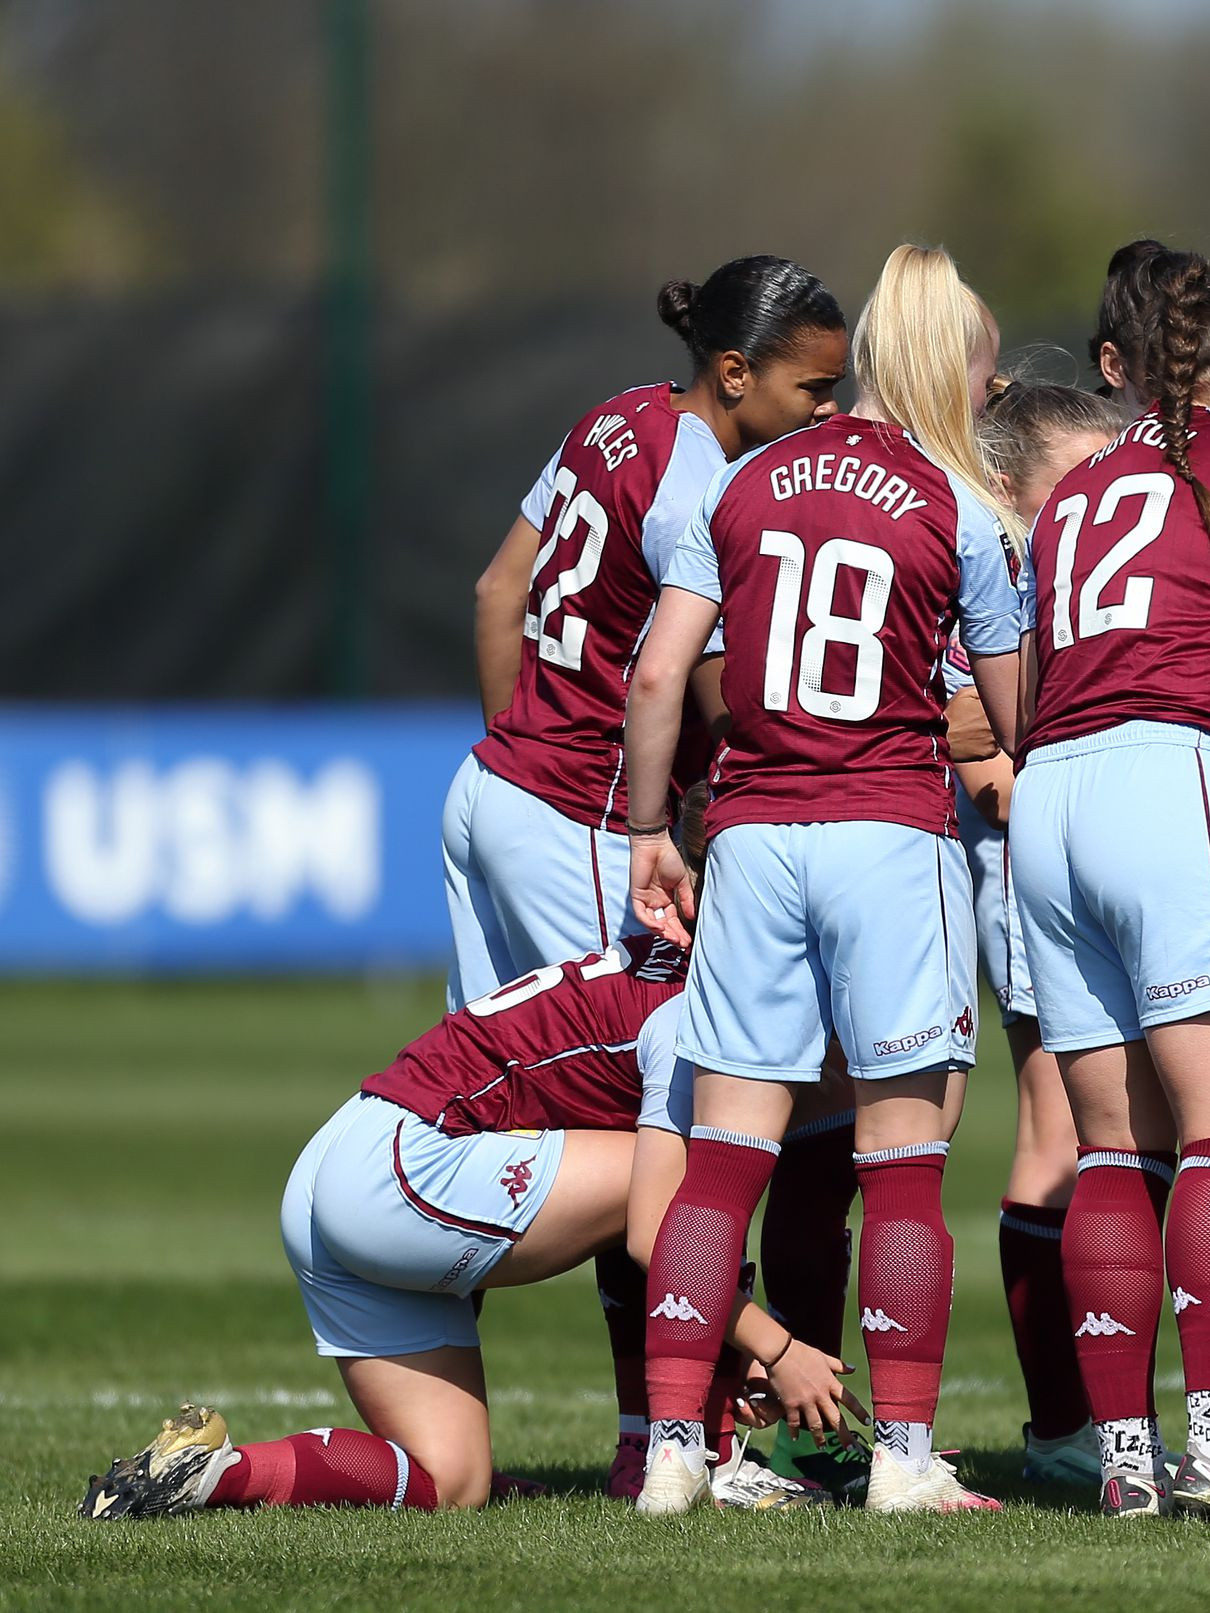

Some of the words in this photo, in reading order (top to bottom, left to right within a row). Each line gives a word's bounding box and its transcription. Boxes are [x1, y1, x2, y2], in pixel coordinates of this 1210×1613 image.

[1088, 418, 1198, 469] HUTTO
[769, 453, 928, 521] GREGORY
[523, 466, 609, 672] 22
[1053, 472, 1176, 650] 12
[759, 529, 895, 722] 18
[1146, 974, 1210, 1001] Kappa
[873, 1025, 943, 1057] Kappa
